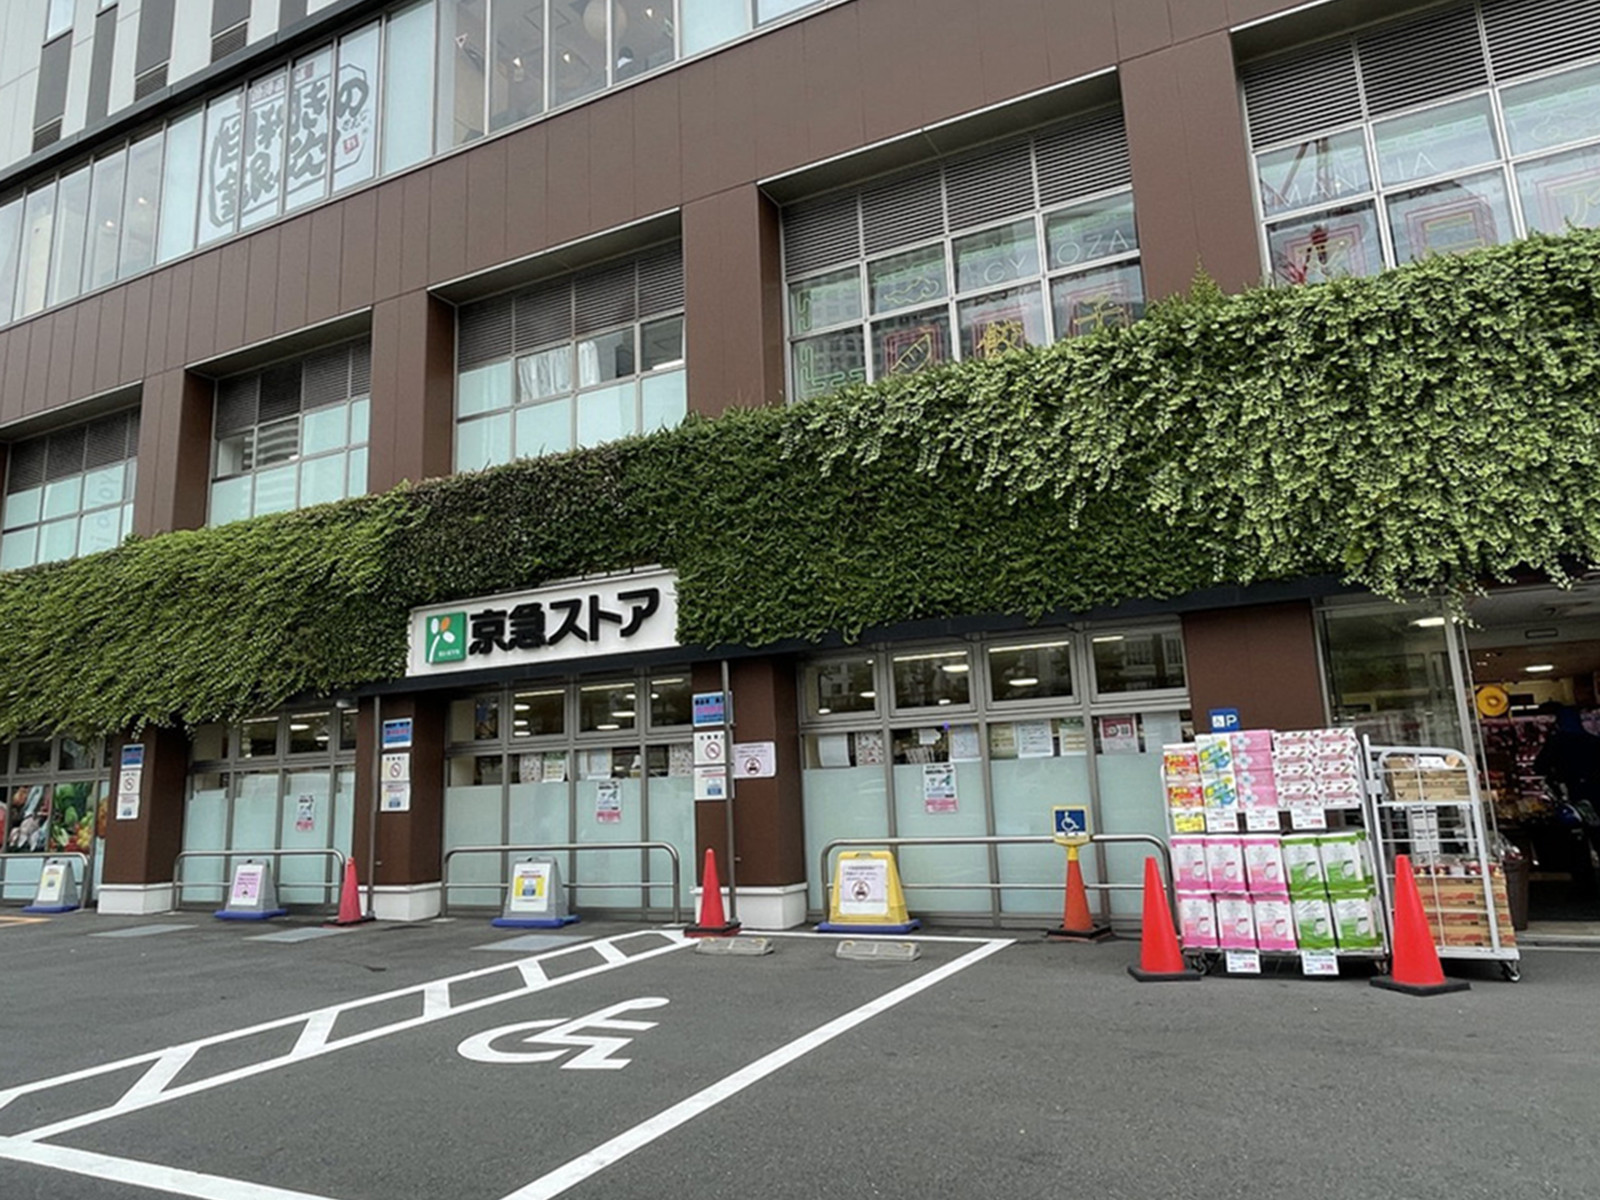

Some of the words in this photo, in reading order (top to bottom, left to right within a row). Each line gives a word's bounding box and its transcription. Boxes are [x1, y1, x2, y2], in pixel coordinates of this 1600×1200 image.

[1262, 151, 1439, 210] MANIA
[983, 229, 1130, 284] GYOZA
[469, 588, 659, 655] 京急ストア
[1226, 714, 1238, 727] P
